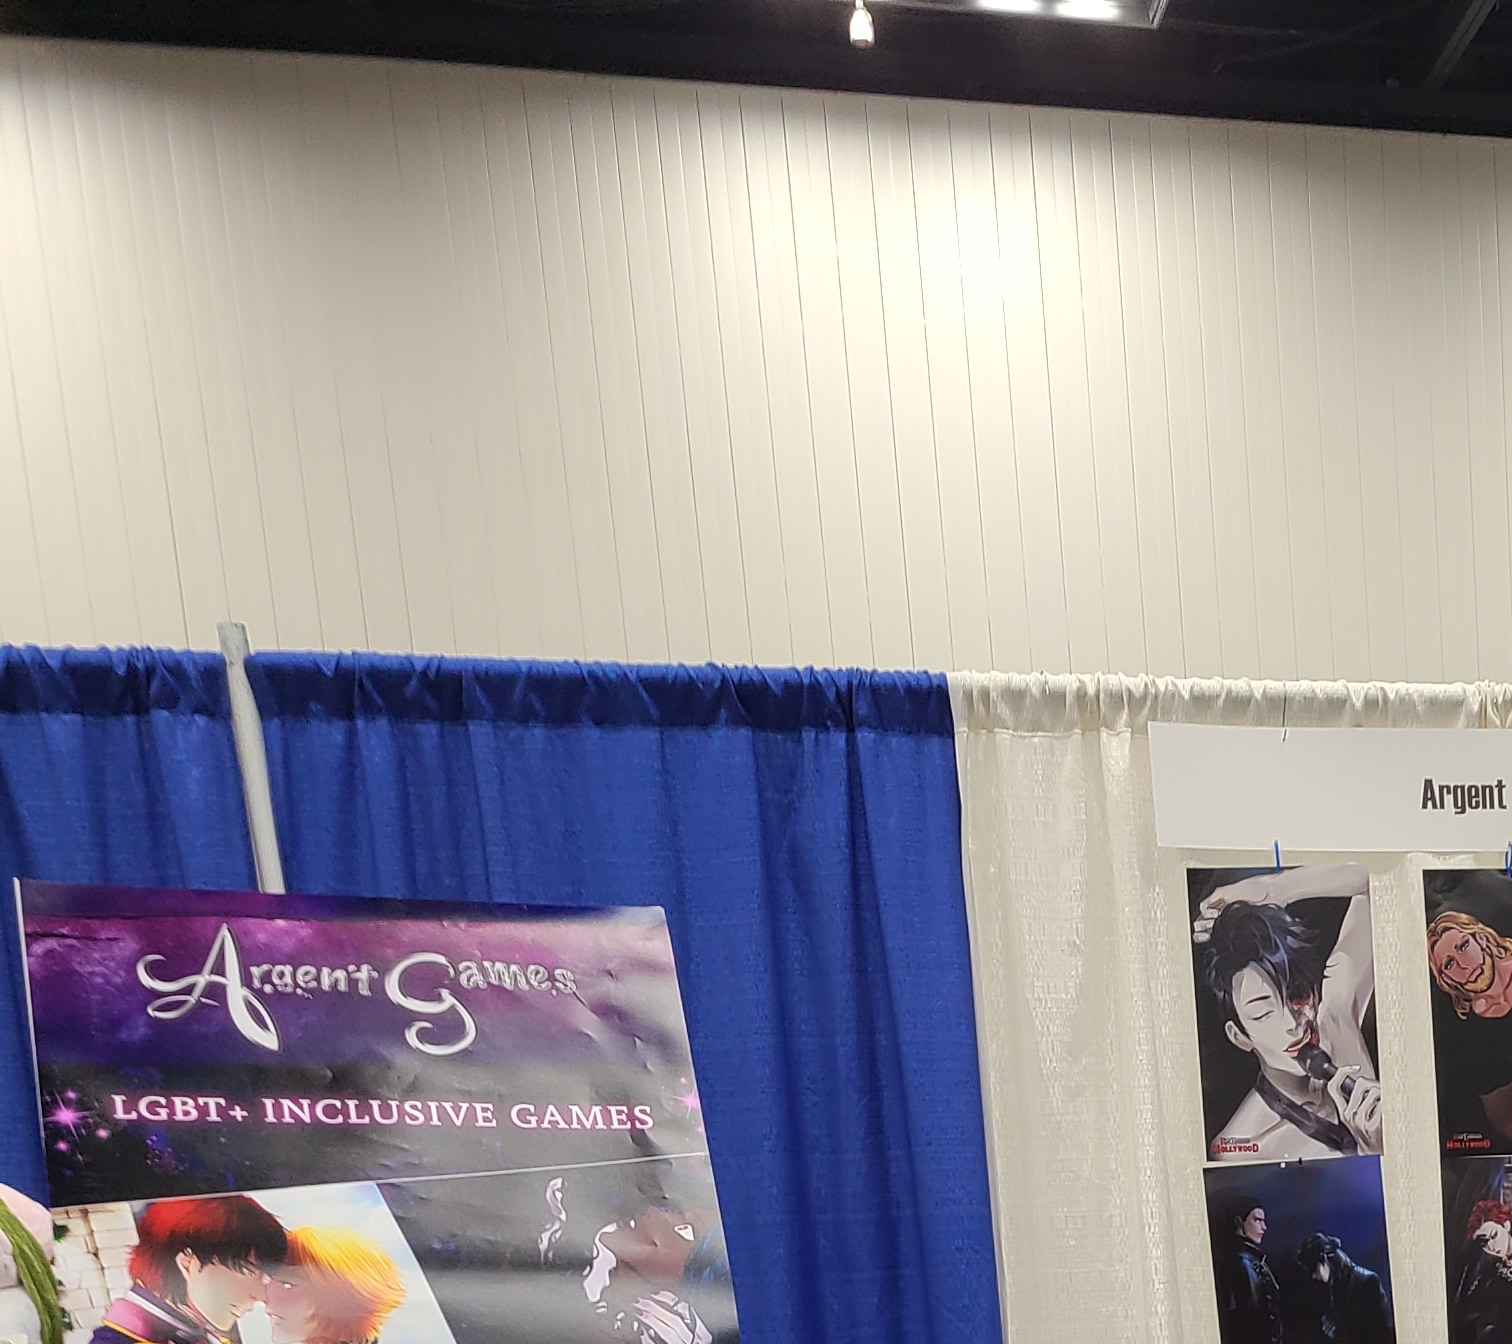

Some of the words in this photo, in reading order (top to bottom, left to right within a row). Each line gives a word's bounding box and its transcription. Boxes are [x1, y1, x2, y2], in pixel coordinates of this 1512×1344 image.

[1421, 778, 1507, 815] Argent
[136, 922, 378, 1051] Argent
[385, 951, 577, 1055] Games
[112, 1093, 249, 1123] LGBT+
[263, 1097, 498, 1130] INCLUSIVE
[510, 1101, 656, 1132] GAMES
